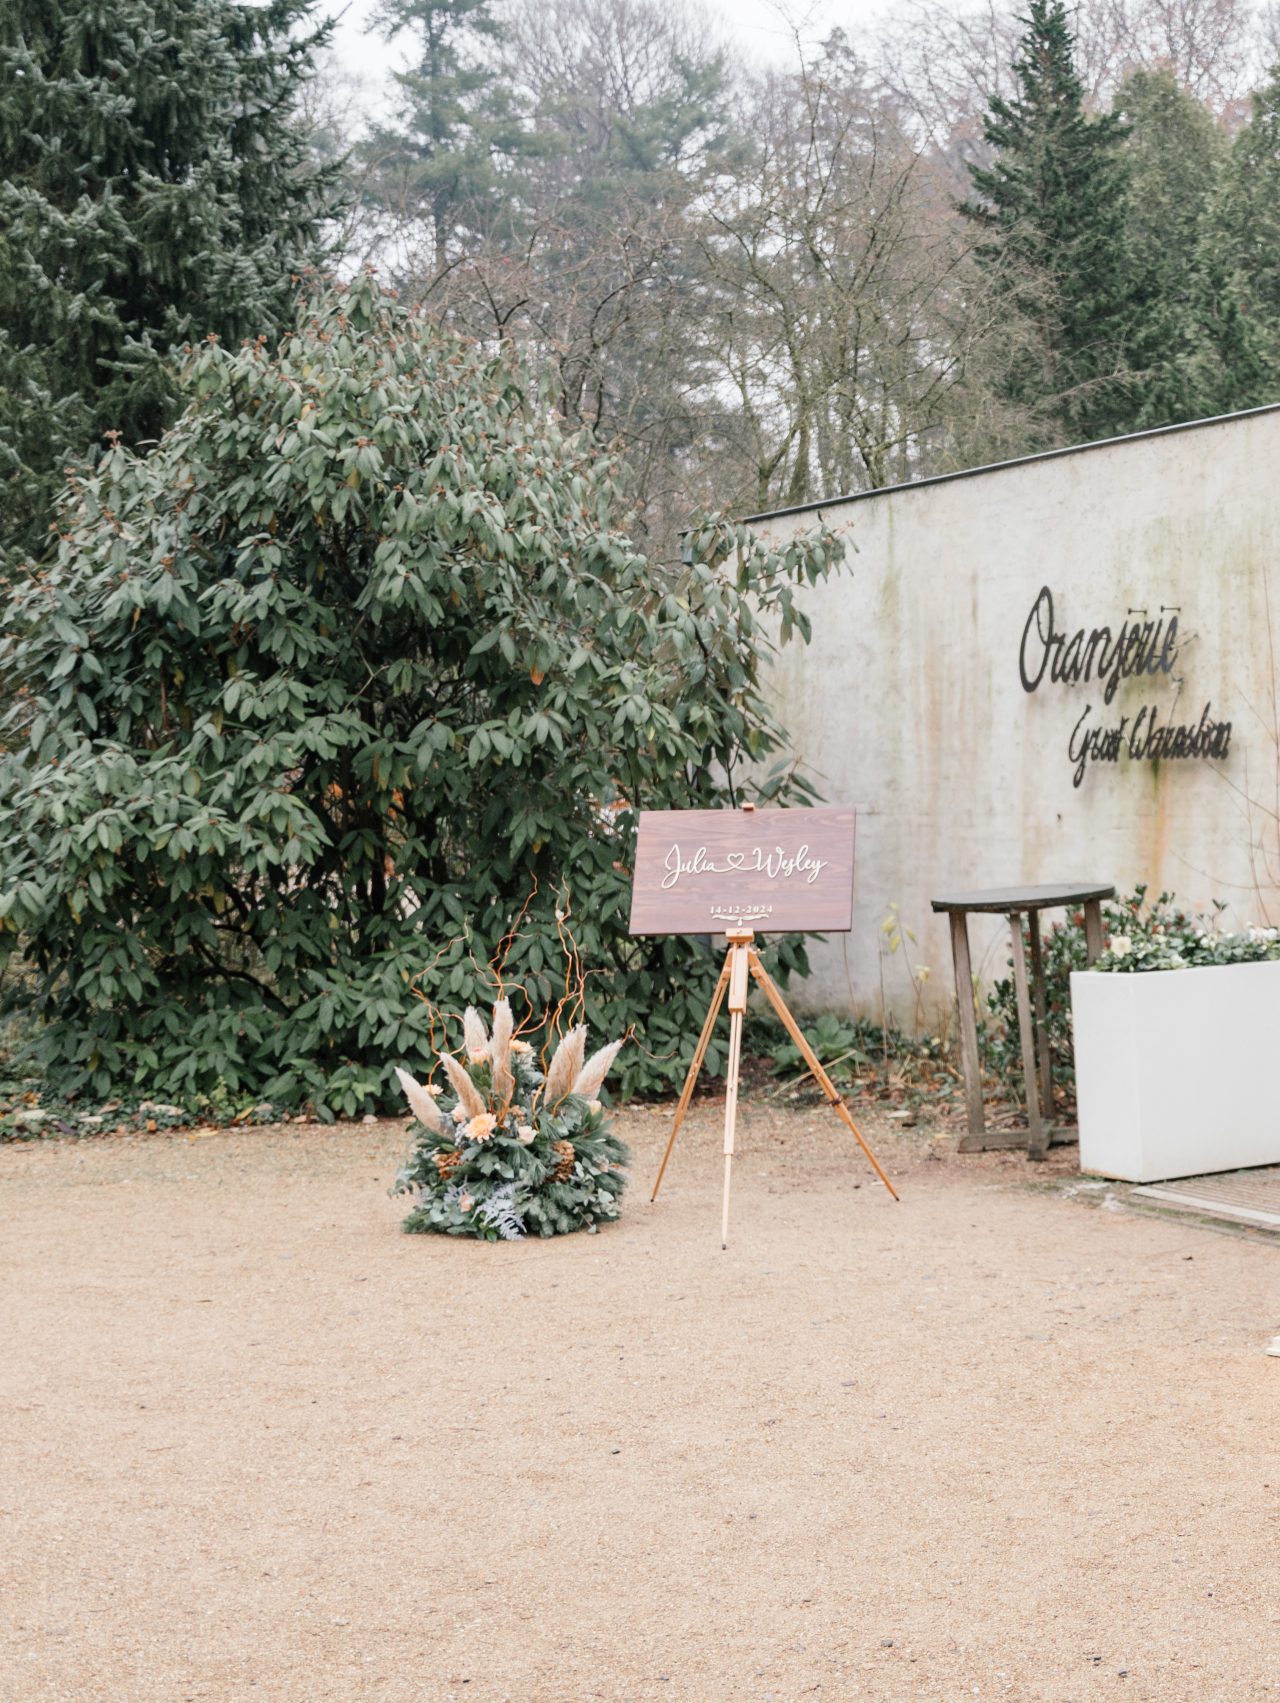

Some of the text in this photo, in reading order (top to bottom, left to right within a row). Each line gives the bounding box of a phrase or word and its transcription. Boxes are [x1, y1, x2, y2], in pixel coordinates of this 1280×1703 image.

[1019, 585, 1180, 706] Oranjerie
[1069, 703, 1129, 788] Groot
[661, 844, 828, 889] Julia Wesley
[709, 904, 773, 914] 14-12-2024
